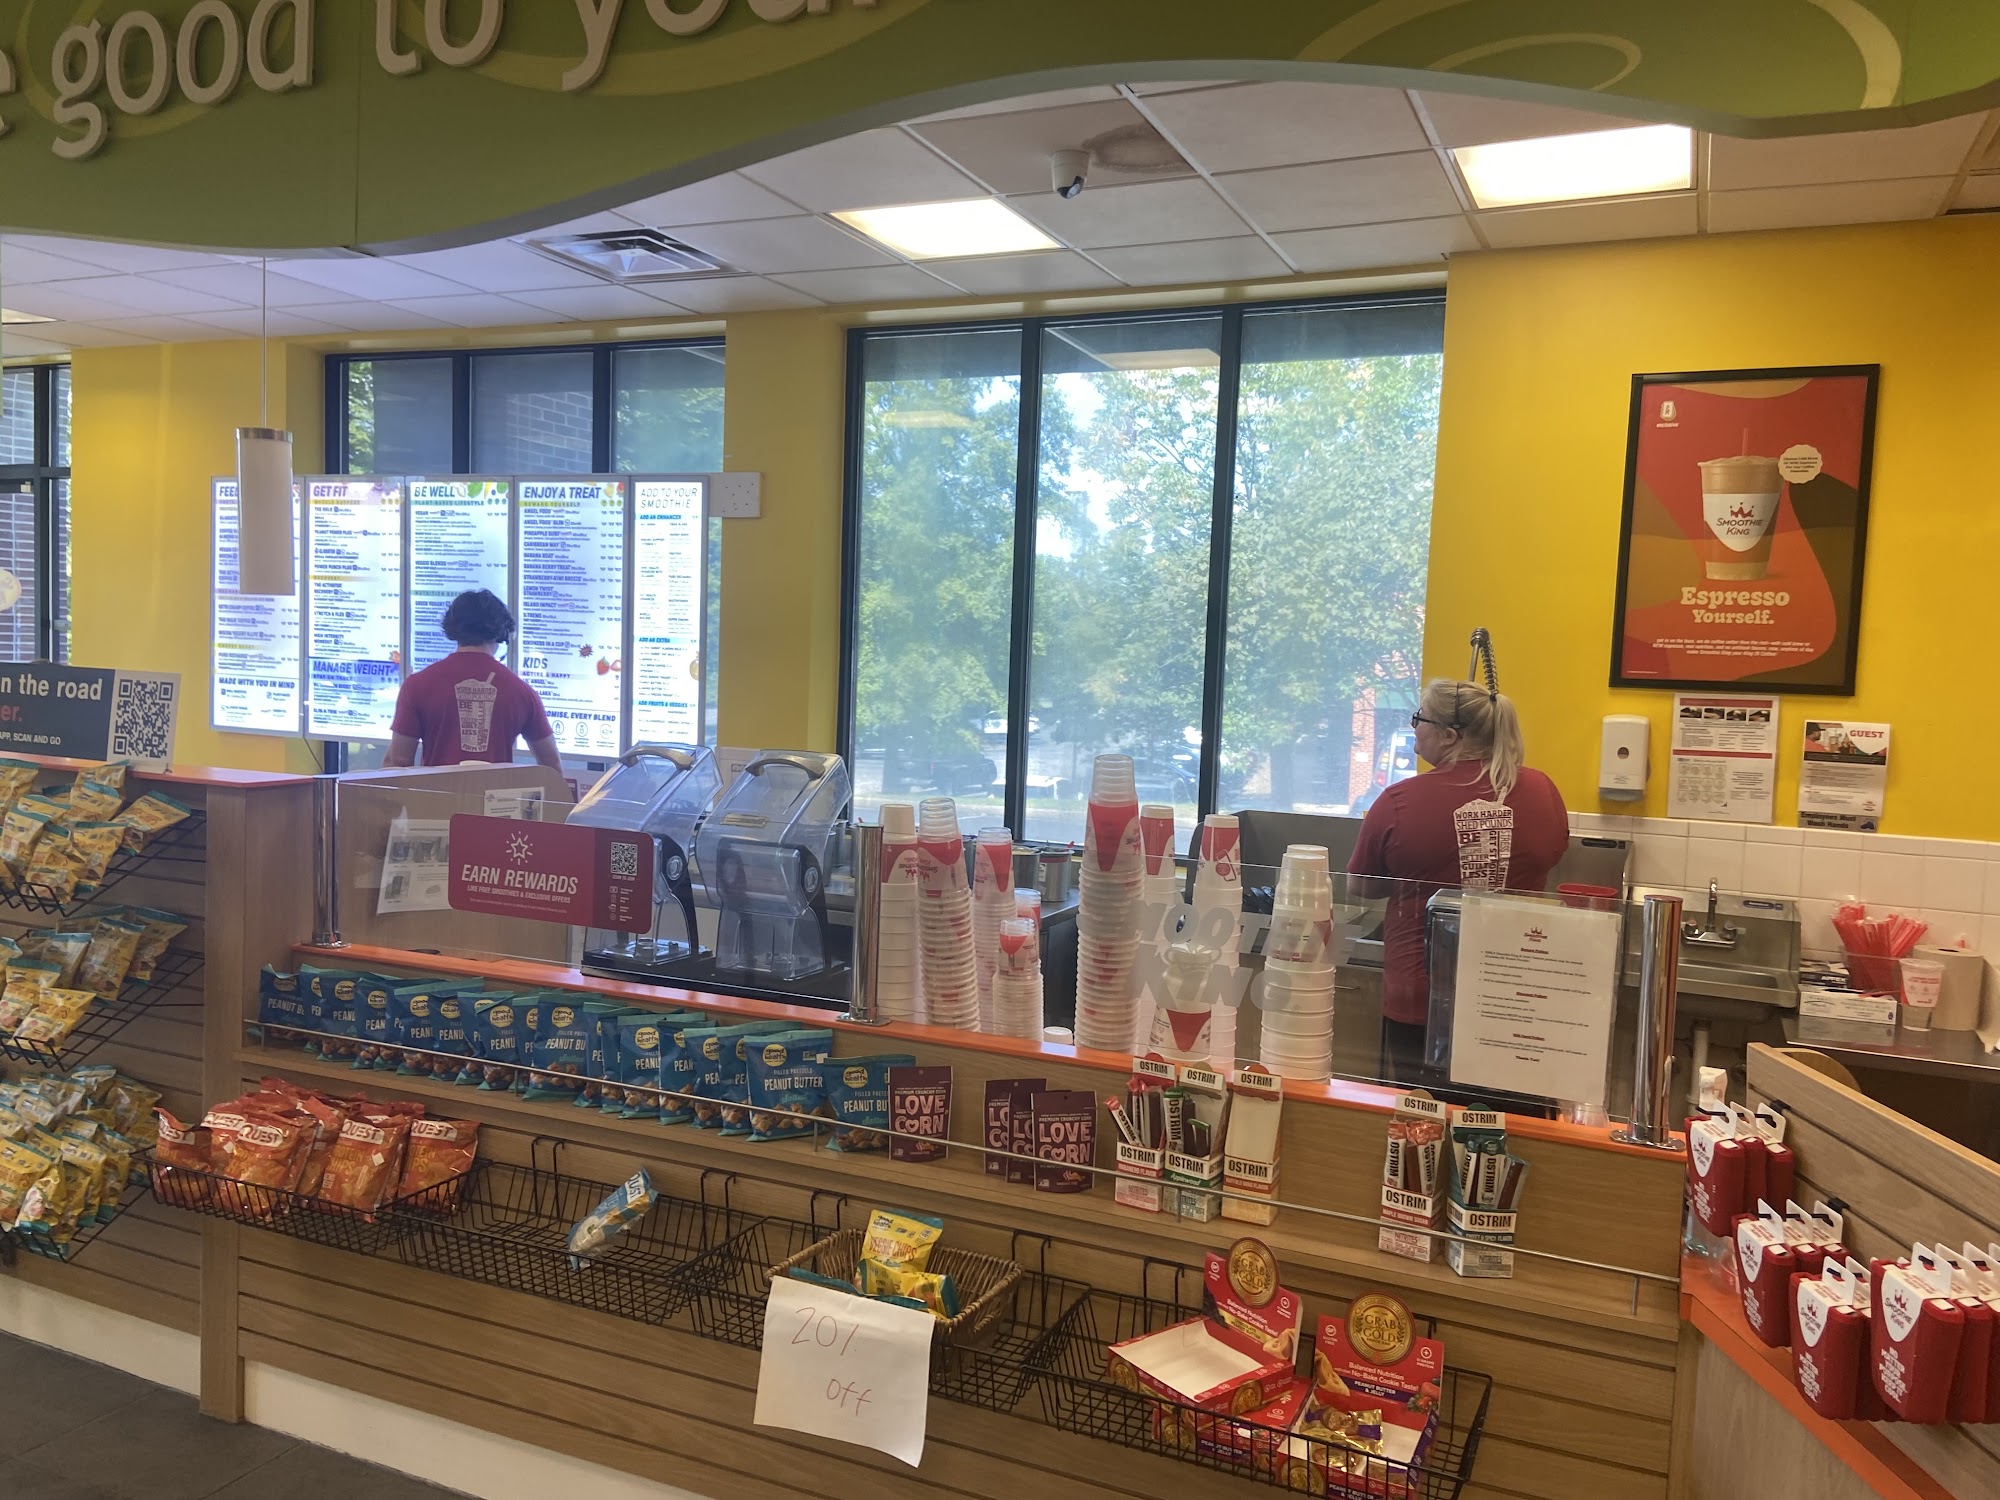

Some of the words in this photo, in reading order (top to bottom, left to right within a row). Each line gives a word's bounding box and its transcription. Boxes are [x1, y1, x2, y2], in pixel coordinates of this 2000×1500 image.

[313, 486, 332, 497] GET
[333, 486, 348, 497] FIT
[414, 486, 427, 497] BE
[430, 486, 455, 497] WELL
[524, 487, 558, 498] ENJOY
[558, 487, 566, 498] A
[569, 487, 601, 498] TREAT
[641, 488, 658, 497] ADD
[661, 488, 671, 497] TO
[674, 488, 697, 497] YOUR
[641, 500, 691, 508] SMOOTHIE
[1717, 518, 1764, 526] SMOOTHIE
[1680, 586, 1790, 609] Espresso
[1692, 609, 1774, 624] Yourself.
[313, 661, 352, 674] MANAGE
[354, 663, 391, 676] WEIGHT
[523, 657, 548, 668] KIDS
[19, 674, 50, 696] the
[56, 679, 102, 700] road
[278, 681, 295, 689] MIND
[460, 701, 472, 709] BE
[13, 732, 31, 742] SCAN
[33, 734, 48, 744] AND
[50, 736, 61, 745] GO
[1850, 730, 1884, 738] GUEST
[1455, 811, 1479, 819] WORK
[1457, 820, 1478, 830] SHED
[1480, 819, 1512, 828] POUNDS
[1460, 832, 1481, 843] BE
[461, 864, 500, 885] EARN
[504, 870, 578, 895] REWARDS
[1463, 870, 1487, 879] LESS
[492, 888, 519, 897] SMOOTHIES
[525, 892, 551, 901] EXCLUSIVE
[551, 894, 571, 903] OFFERS
[268, 998, 295, 1012] PEANUT
[555, 1009, 572, 1017] good
[545, 1038, 573, 1050] PEANUT
[763, 1052, 787, 1061] health
[765, 1047, 785, 1056] good
[790, 1067, 813, 1075] PRETZELS
[845, 1069, 865, 1079] good
[1139, 1060, 1168, 1075] OSTRIM
[764, 1077, 792, 1091] PEANUT
[794, 1076, 823, 1089] BUTTER
[844, 1075, 869, 1083] health
[1187, 1069, 1216, 1084] OSTRIM
[1240, 1074, 1272, 1088] OSTRIM
[843, 1100, 874, 1113] PEANUT
[1404, 1097, 1438, 1113] OSTRIM
[1169, 1099, 1181, 1140] OSTRIM
[1462, 1112, 1497, 1124] OSTRIM
[240, 1124, 279, 1144] QUEST
[342, 1120, 380, 1140] QUEST
[411, 1119, 454, 1137] QUEST
[1120, 1146, 1156, 1164] OSTRIM
[1389, 1142, 1400, 1177] OSTRIM
[1169, 1154, 1204, 1174] OSTRIM
[1228, 1160, 1268, 1178] OSTRIM
[1169, 1173, 1202, 1186] Applewood
[1486, 1157, 1497, 1194] OSTRIM
[1385, 1189, 1427, 1211] OSTRIM
[1469, 1213, 1512, 1227] OSTRIM
[869, 1236, 893, 1256] VEGGIE
[892, 1240, 917, 1261] CHIPS
[1242, 1258, 1265, 1276] GRAB
[1239, 1271, 1263, 1288] GOLD
[1365, 1314, 1396, 1330] GRAB
[1363, 1328, 1396, 1342] GOLD
[1349, 1362, 1376, 1373] Balanced
[1377, 1369, 1404, 1381] Nutrition
[1351, 1371, 1378, 1381] No-Bake
[1379, 1377, 1399, 1387] Cookie
[1401, 1381, 1419, 1391] Taste!
[1354, 1380, 1375, 1390] PEANUT
[1376, 1385, 1396, 1394] BUTTER
[1370, 1389, 1385, 1397] JELLY
